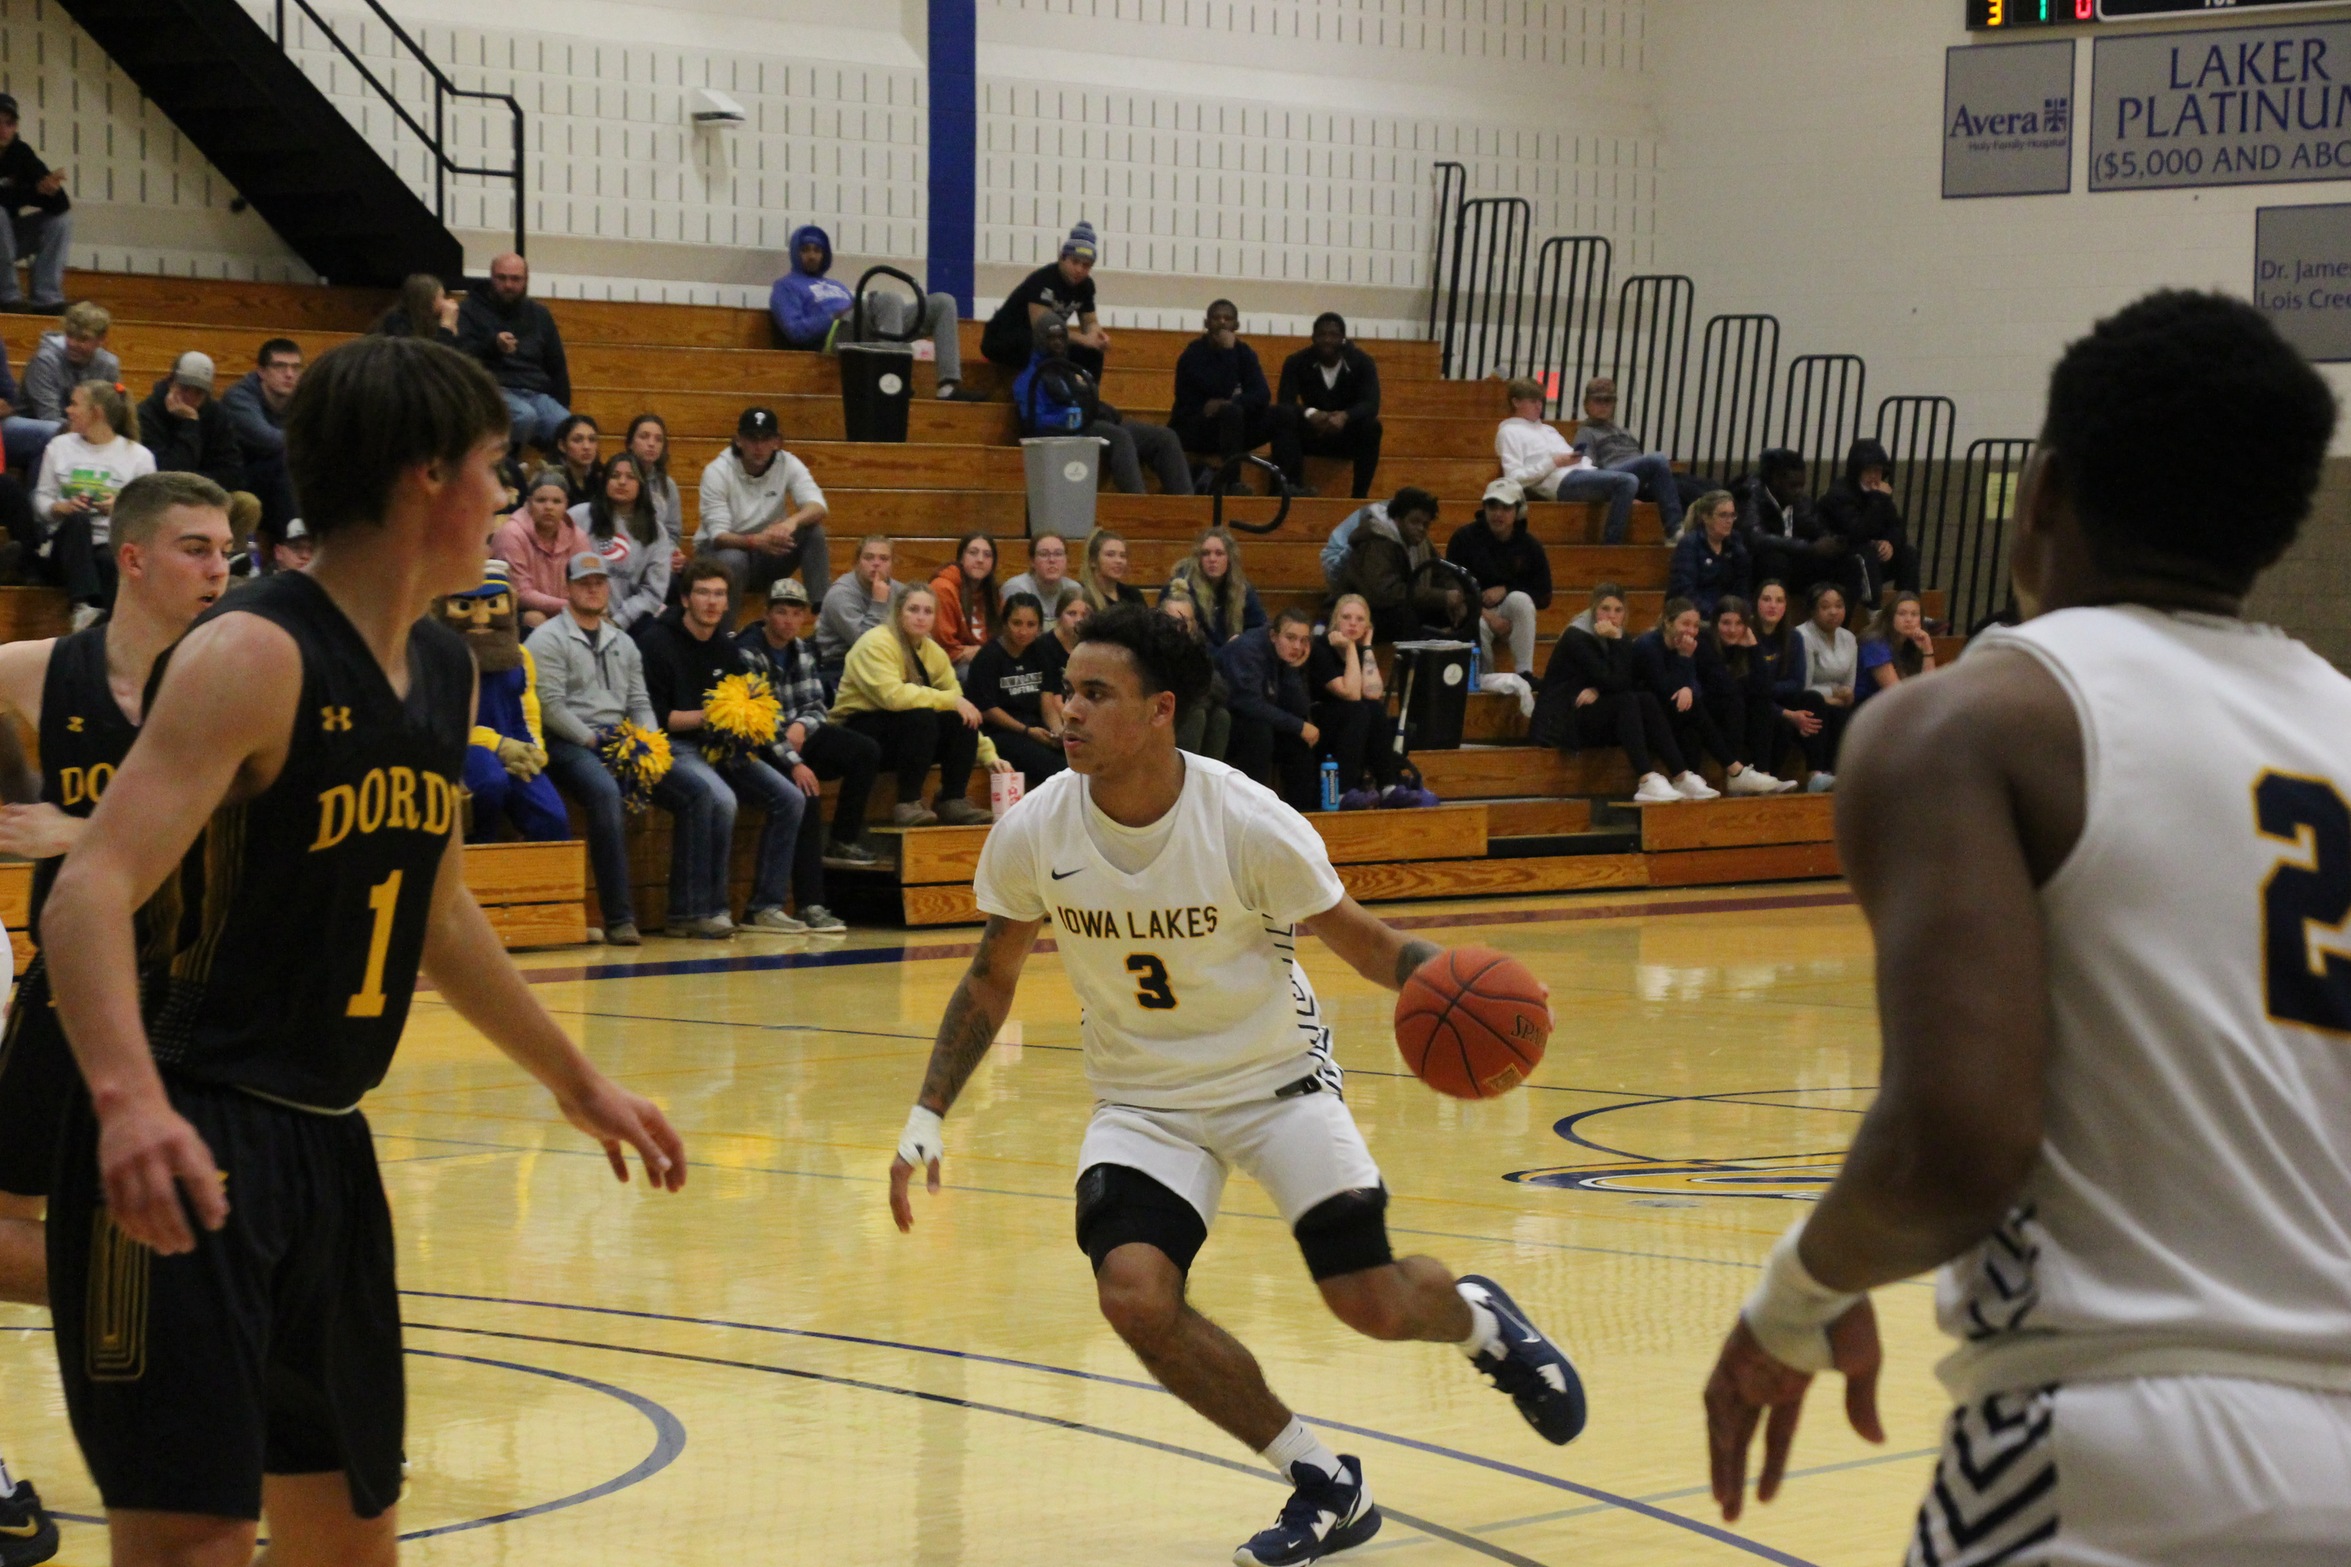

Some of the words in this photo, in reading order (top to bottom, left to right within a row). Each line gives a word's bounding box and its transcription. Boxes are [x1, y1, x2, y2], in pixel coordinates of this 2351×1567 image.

[2170, 38, 2331, 90] LAKER
[1949, 103, 2039, 137] Avera
[2095, 148, 2203, 184] ($5,000
[2212, 144, 2282, 173] AND
[2261, 260, 2289, 280] Dr.
[2260, 290, 2303, 311] Lois
[1057, 905, 1121, 939] IOWA
[1127, 905, 1219, 939] LAKES
[345, 869, 404, 1018] 1
[1123, 952, 1180, 1011] 3
